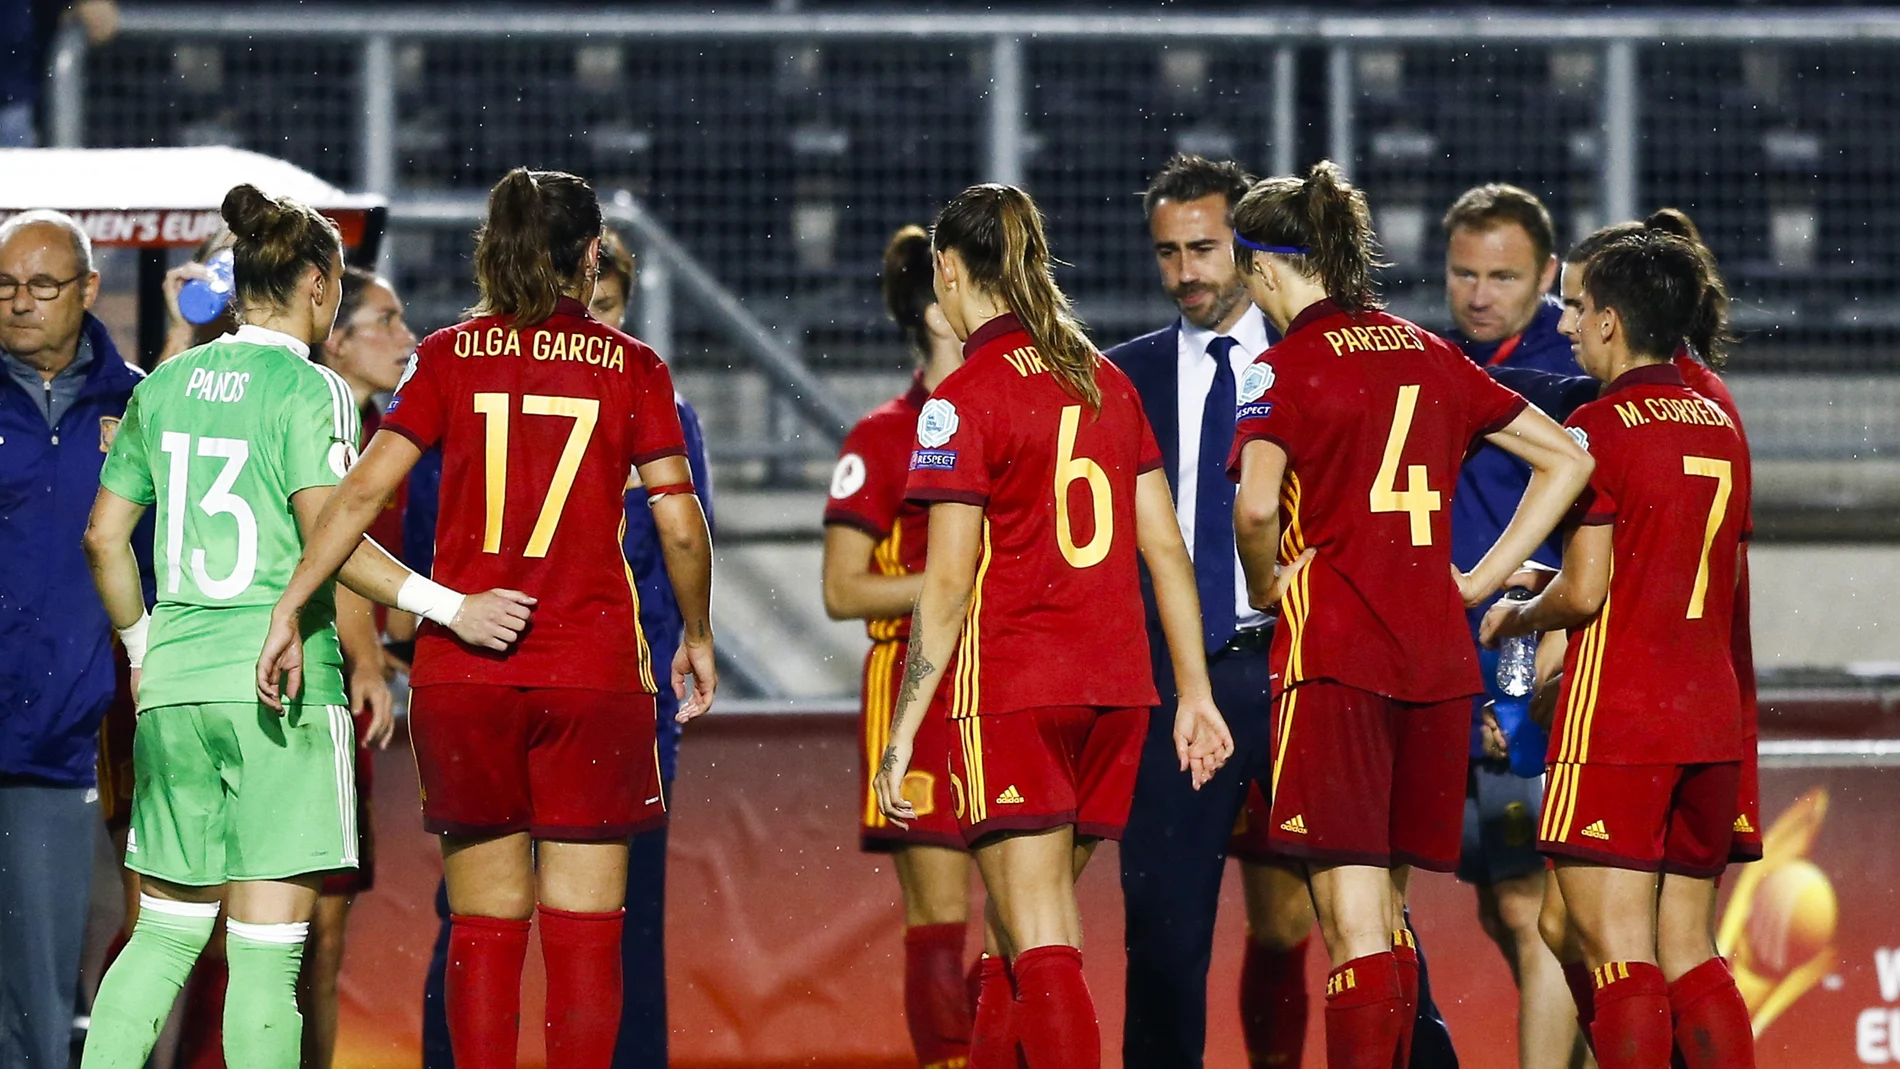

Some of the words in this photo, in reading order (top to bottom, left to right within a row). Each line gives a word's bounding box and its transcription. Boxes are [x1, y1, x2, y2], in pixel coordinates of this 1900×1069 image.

[72, 211, 160, 241] MEN'S
[454, 327, 522, 359] OLGA
[532, 329, 624, 374] GARCÍA
[1323, 324, 1425, 357] PAREDES
[1002, 346, 1050, 377] VIR
[1614, 401, 1650, 428] M.
[473, 392, 600, 558] 17
[917, 453, 955, 465] RESPECT
[1369, 384, 1441, 546] 4
[1055, 405, 1113, 568] 6
[161, 431, 258, 600] 13
[1683, 455, 1732, 619] 7
[1280, 823, 1308, 834] adidas
[1581, 829, 1609, 840] adidas
